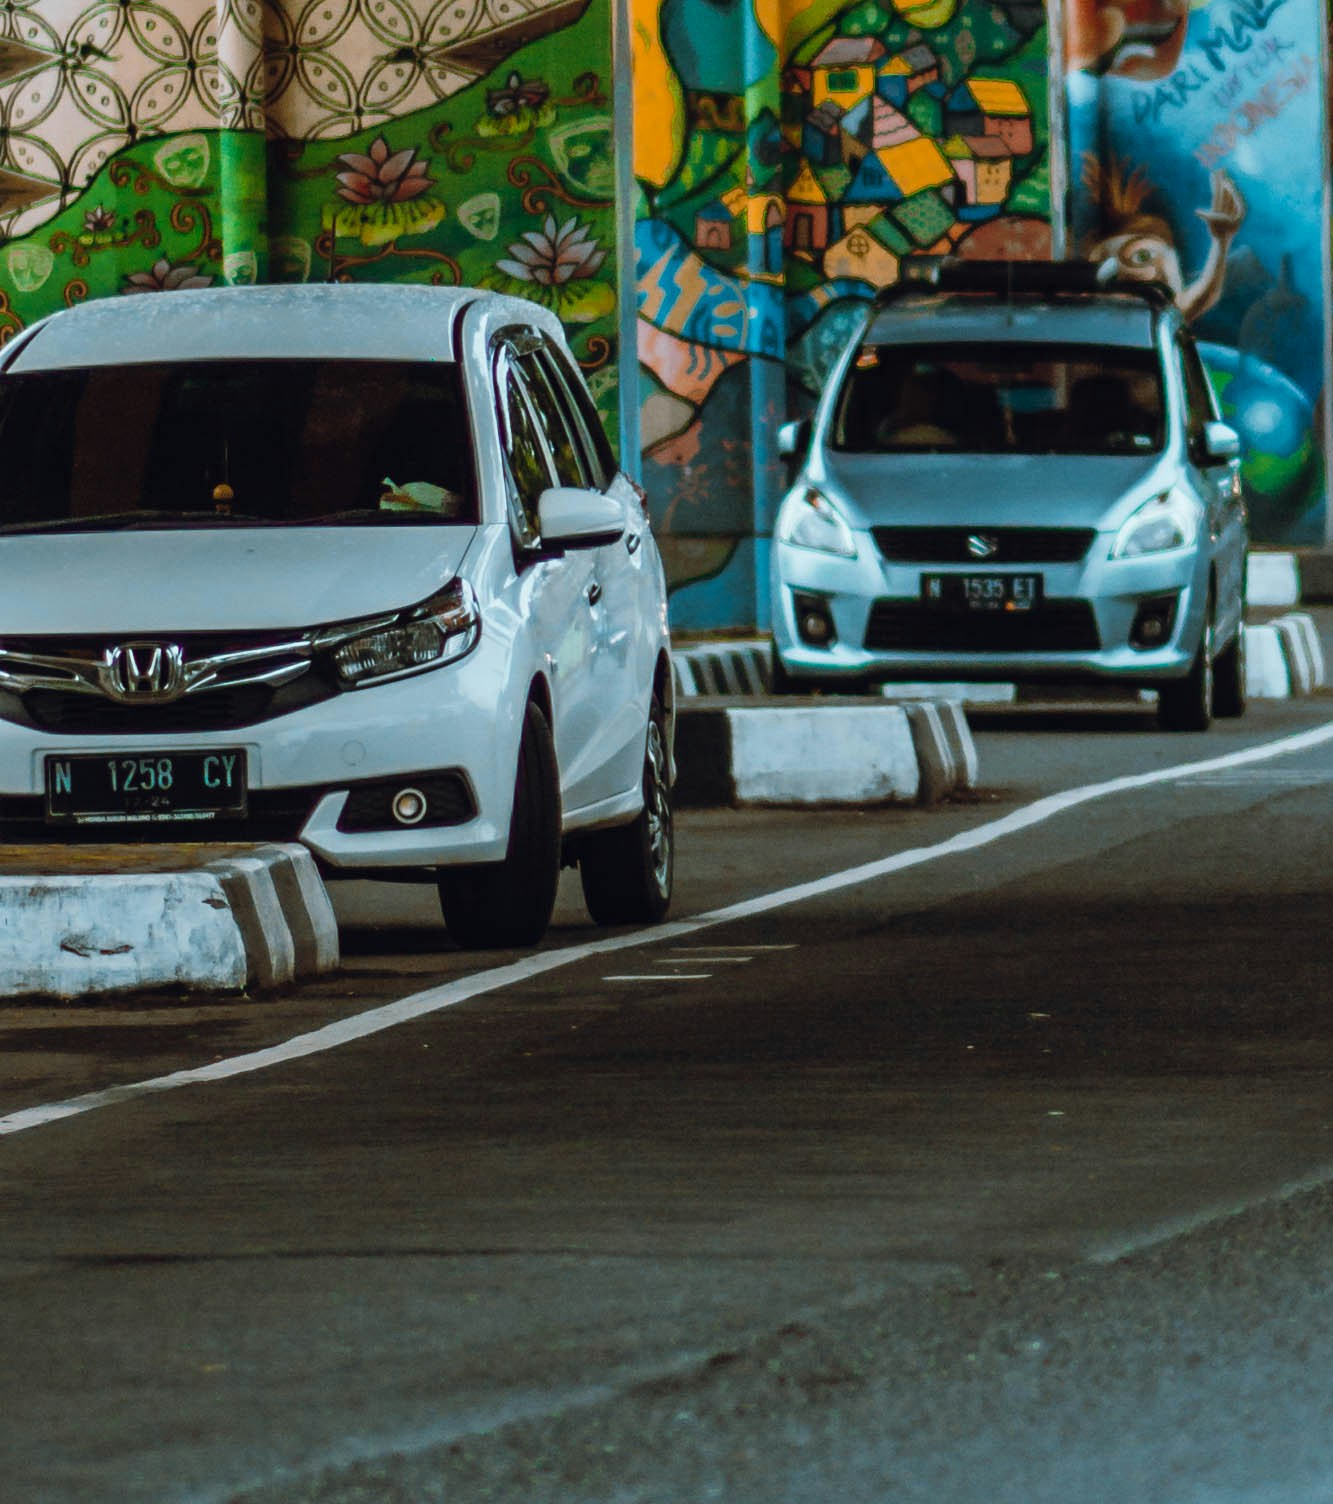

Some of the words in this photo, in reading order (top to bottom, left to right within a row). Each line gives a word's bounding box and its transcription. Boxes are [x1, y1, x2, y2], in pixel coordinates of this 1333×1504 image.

[55, 761, 72, 794] N
[107, 758, 174, 793] 1258
[203, 754, 237, 789] CY
